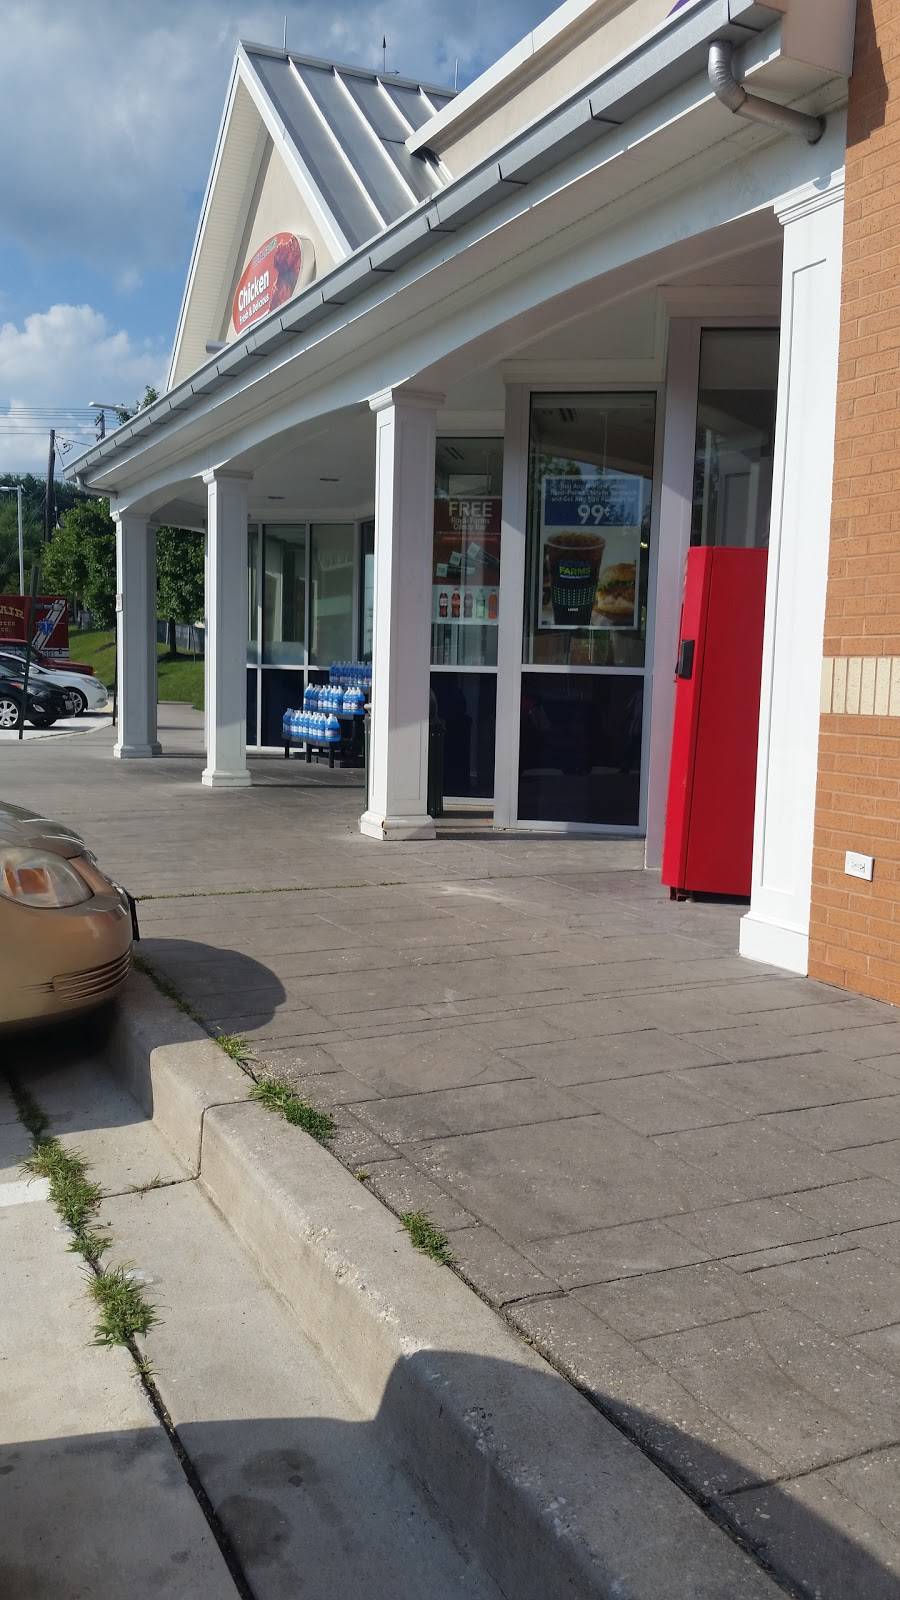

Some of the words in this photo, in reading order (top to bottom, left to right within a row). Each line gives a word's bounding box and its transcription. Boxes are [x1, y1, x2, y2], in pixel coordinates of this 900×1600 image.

[238, 270, 269, 312] Chicken
[449, 502, 493, 517] FREE
[560, 566, 591, 576] FARMS
